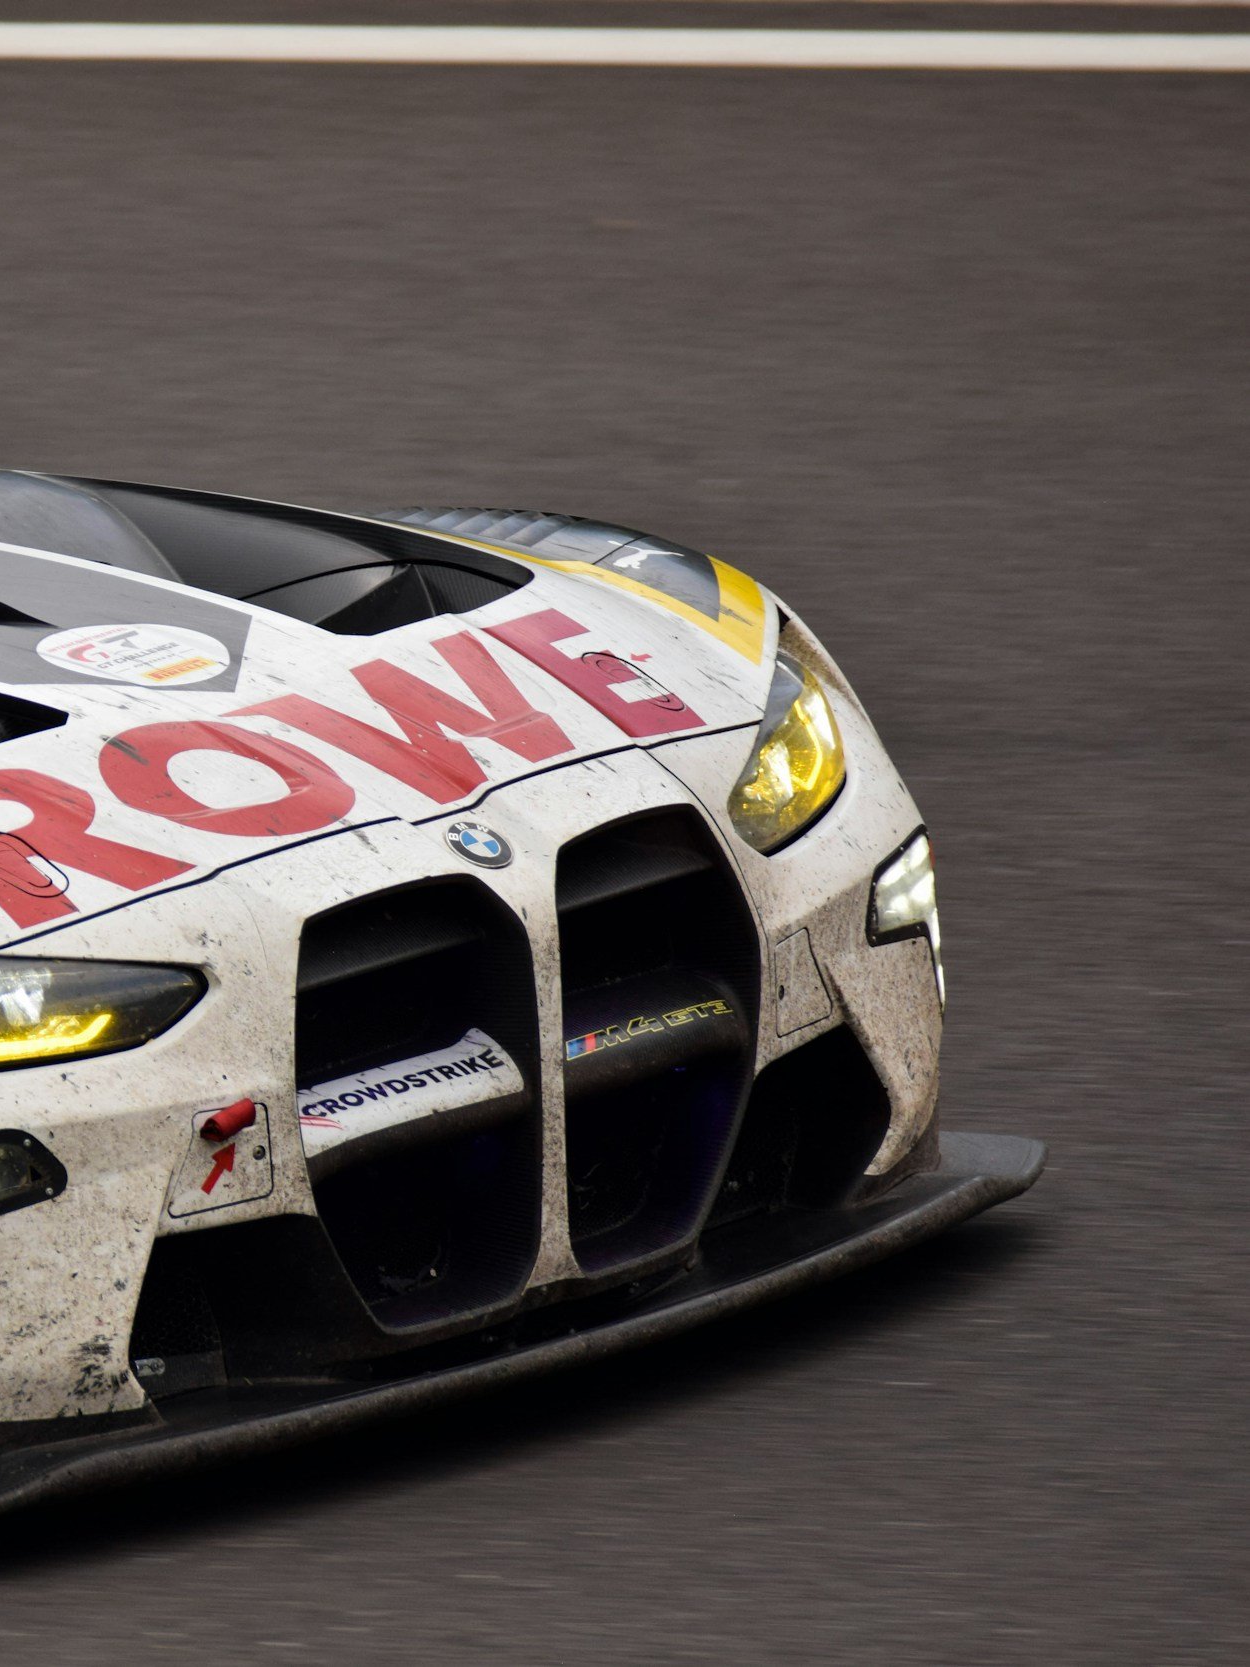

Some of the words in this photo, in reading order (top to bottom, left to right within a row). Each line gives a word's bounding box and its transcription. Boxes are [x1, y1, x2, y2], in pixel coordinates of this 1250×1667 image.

[448, 822, 489, 842] BMW
[592, 1015, 664, 1052] M4
[662, 999, 734, 1026] GT3
[301, 1048, 505, 1117] CROWDSTRIKE
